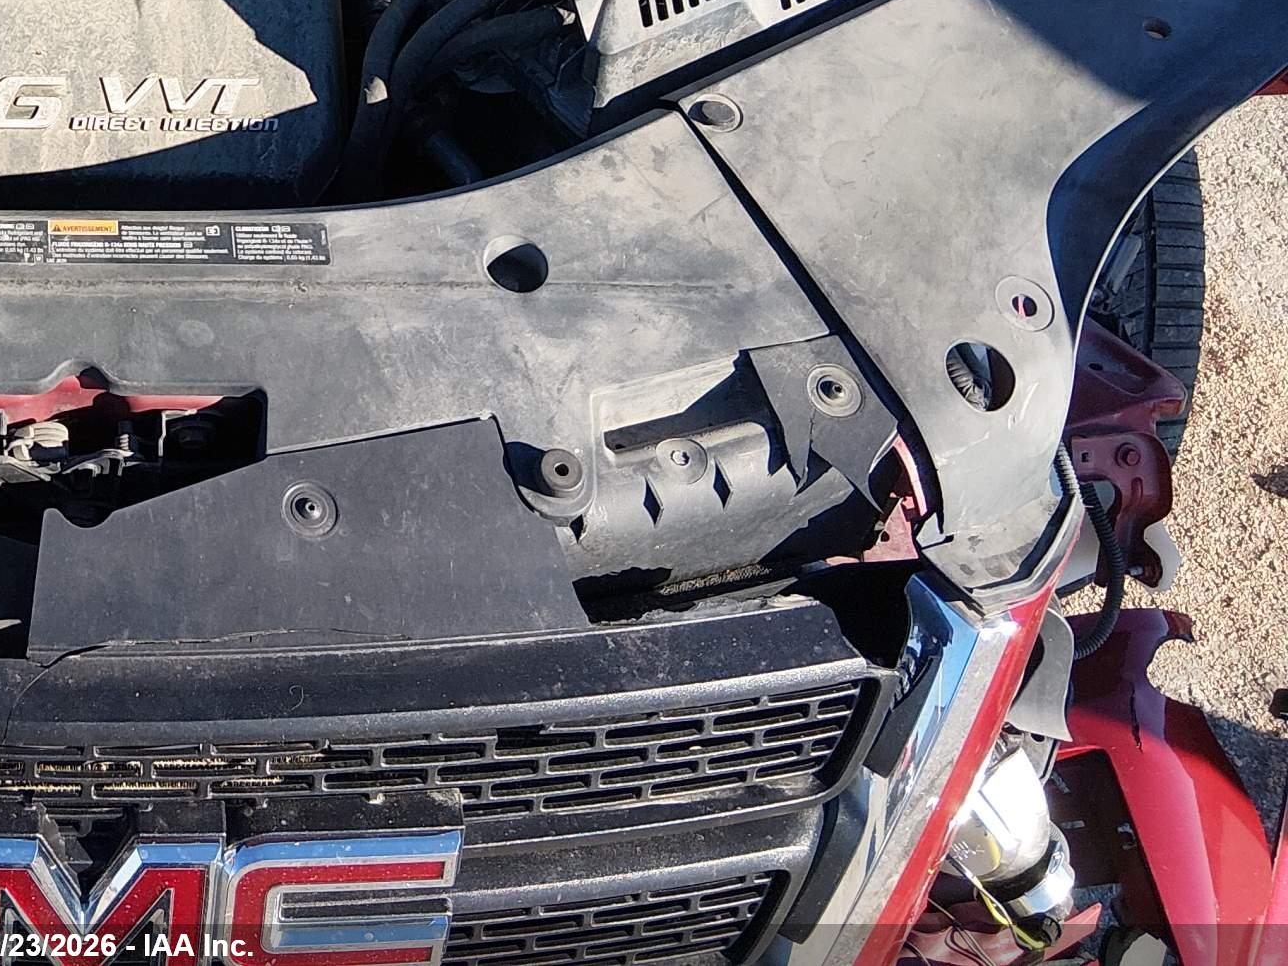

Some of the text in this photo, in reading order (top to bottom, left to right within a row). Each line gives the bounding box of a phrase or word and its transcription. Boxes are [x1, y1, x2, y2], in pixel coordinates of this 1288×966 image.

[99, 76, 260, 114] VVT
[68, 116, 279, 132] DIRECT INJECTION
